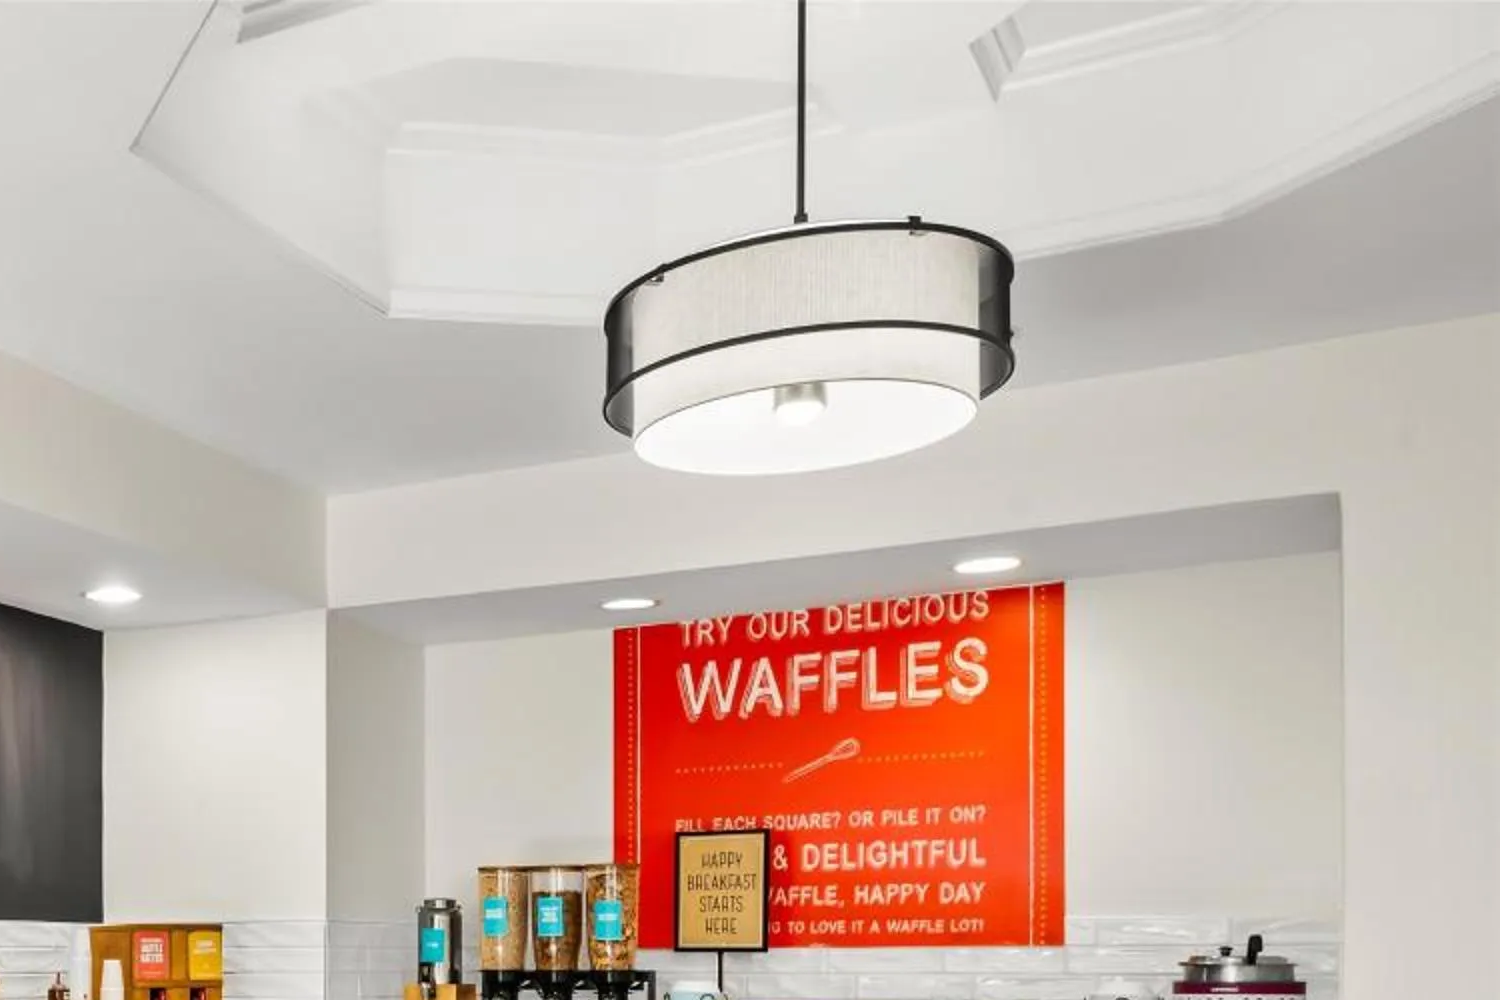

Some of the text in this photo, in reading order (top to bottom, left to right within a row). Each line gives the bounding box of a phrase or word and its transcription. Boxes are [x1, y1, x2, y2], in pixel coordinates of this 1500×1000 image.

[680, 590, 990, 648] TRY OUR DELICIOUS
[676, 636, 989, 723] WAFFLES
[675, 804, 987, 833] FILL EACH SQUARE? OR PILE IT ON?
[701, 851, 743, 869] HAPPY
[772, 837, 987, 871] & DELIGHTFUL
[687, 873, 757, 891] BREAKFAST
[699, 895, 744, 913] STARTS
[768, 881, 987, 908] AFFLE, HAPPY DAY
[705, 917, 737, 935] HERE
[787, 920, 805, 935] TO
[809, 919, 846, 935] LOVE
[851, 919, 865, 934] IT
[869, 919, 881, 934] A
[886, 918, 945, 934] WAFFLE
